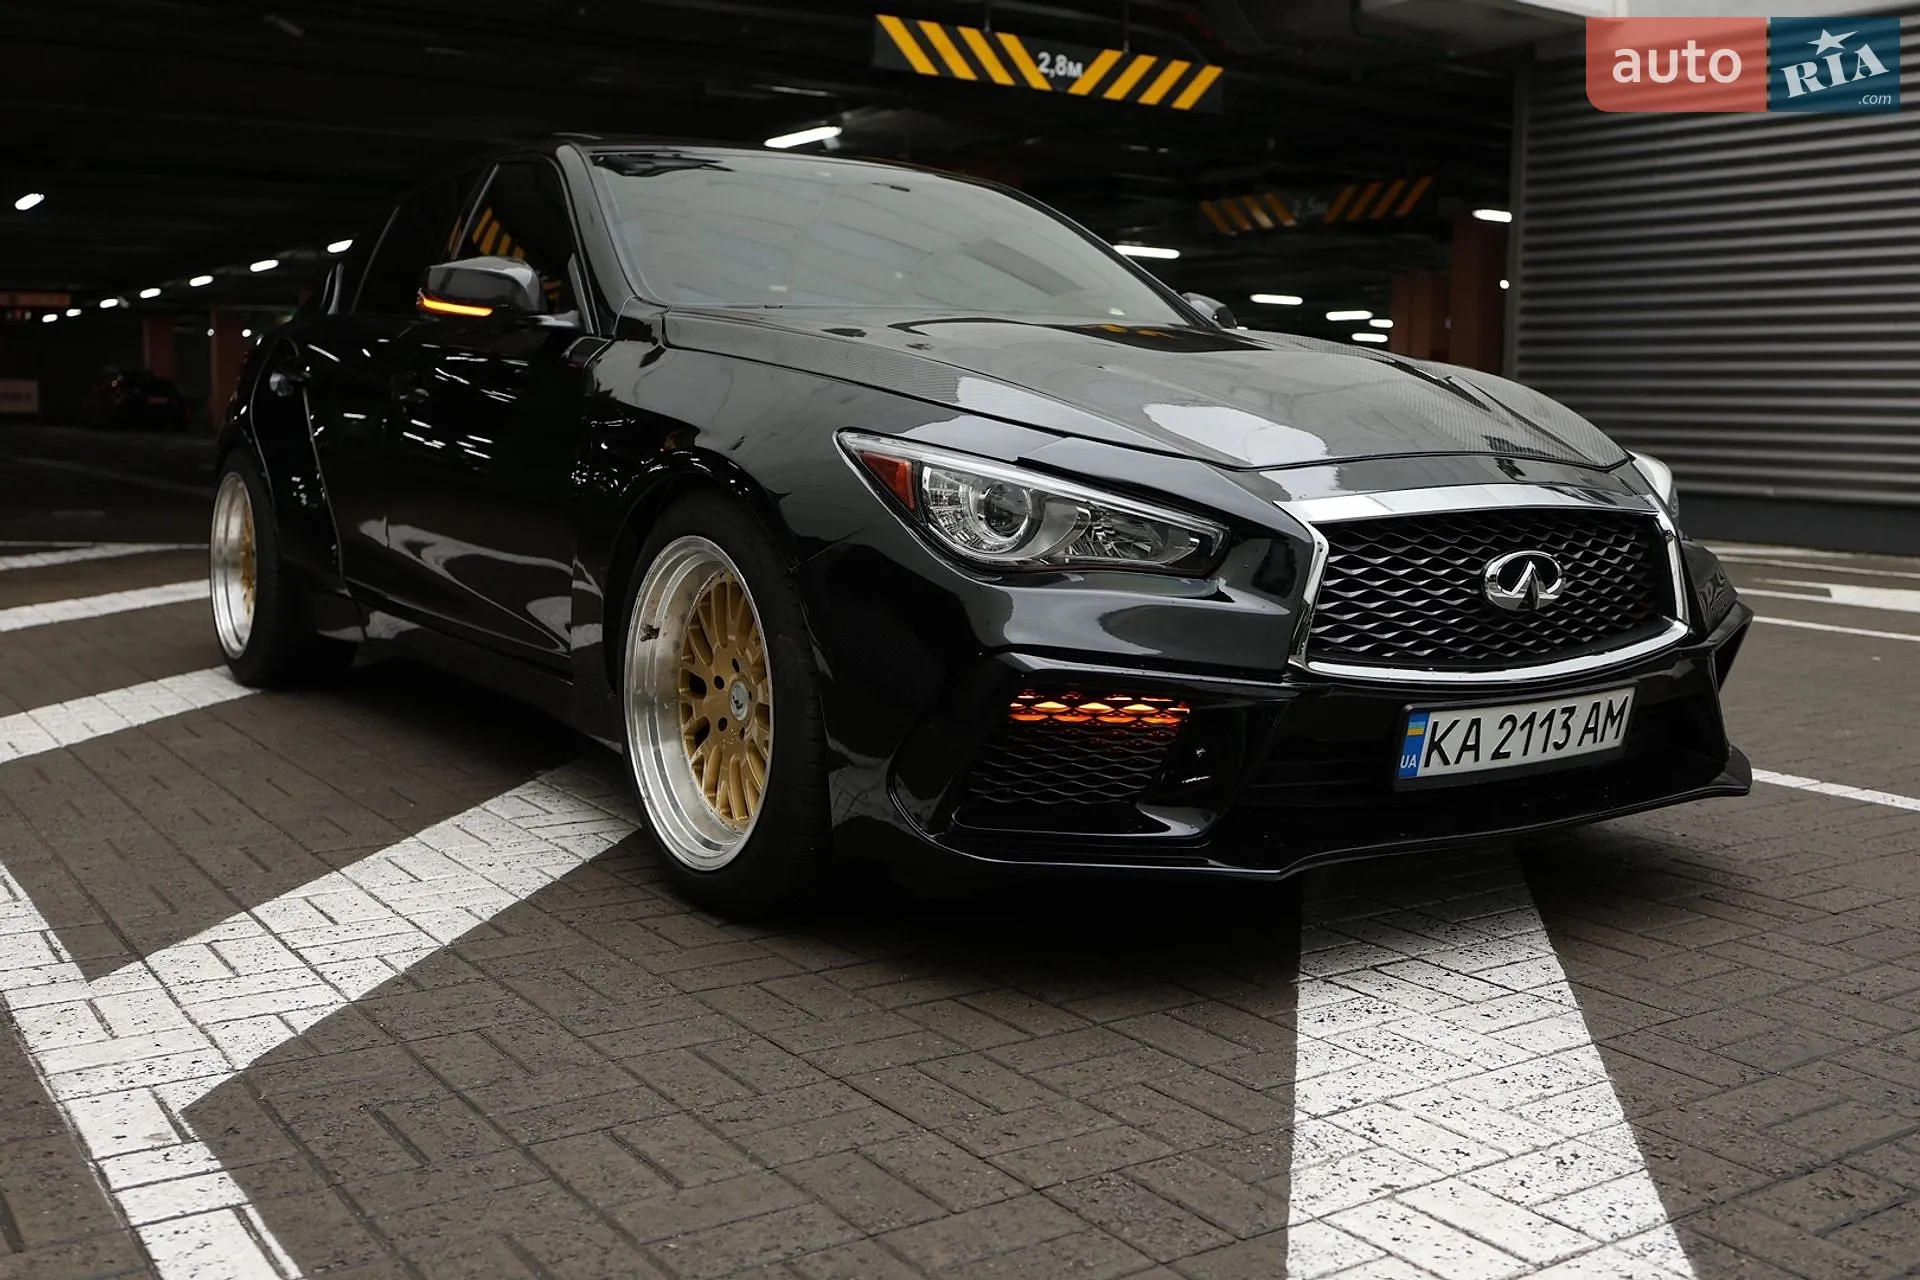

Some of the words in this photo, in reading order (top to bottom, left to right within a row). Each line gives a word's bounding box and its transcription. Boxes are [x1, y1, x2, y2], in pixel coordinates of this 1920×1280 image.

[1423, 717, 1482, 768] KA
[1490, 705, 1577, 761] 2113
[1577, 695, 1629, 747] AM
[1399, 755, 1417, 769] UA
